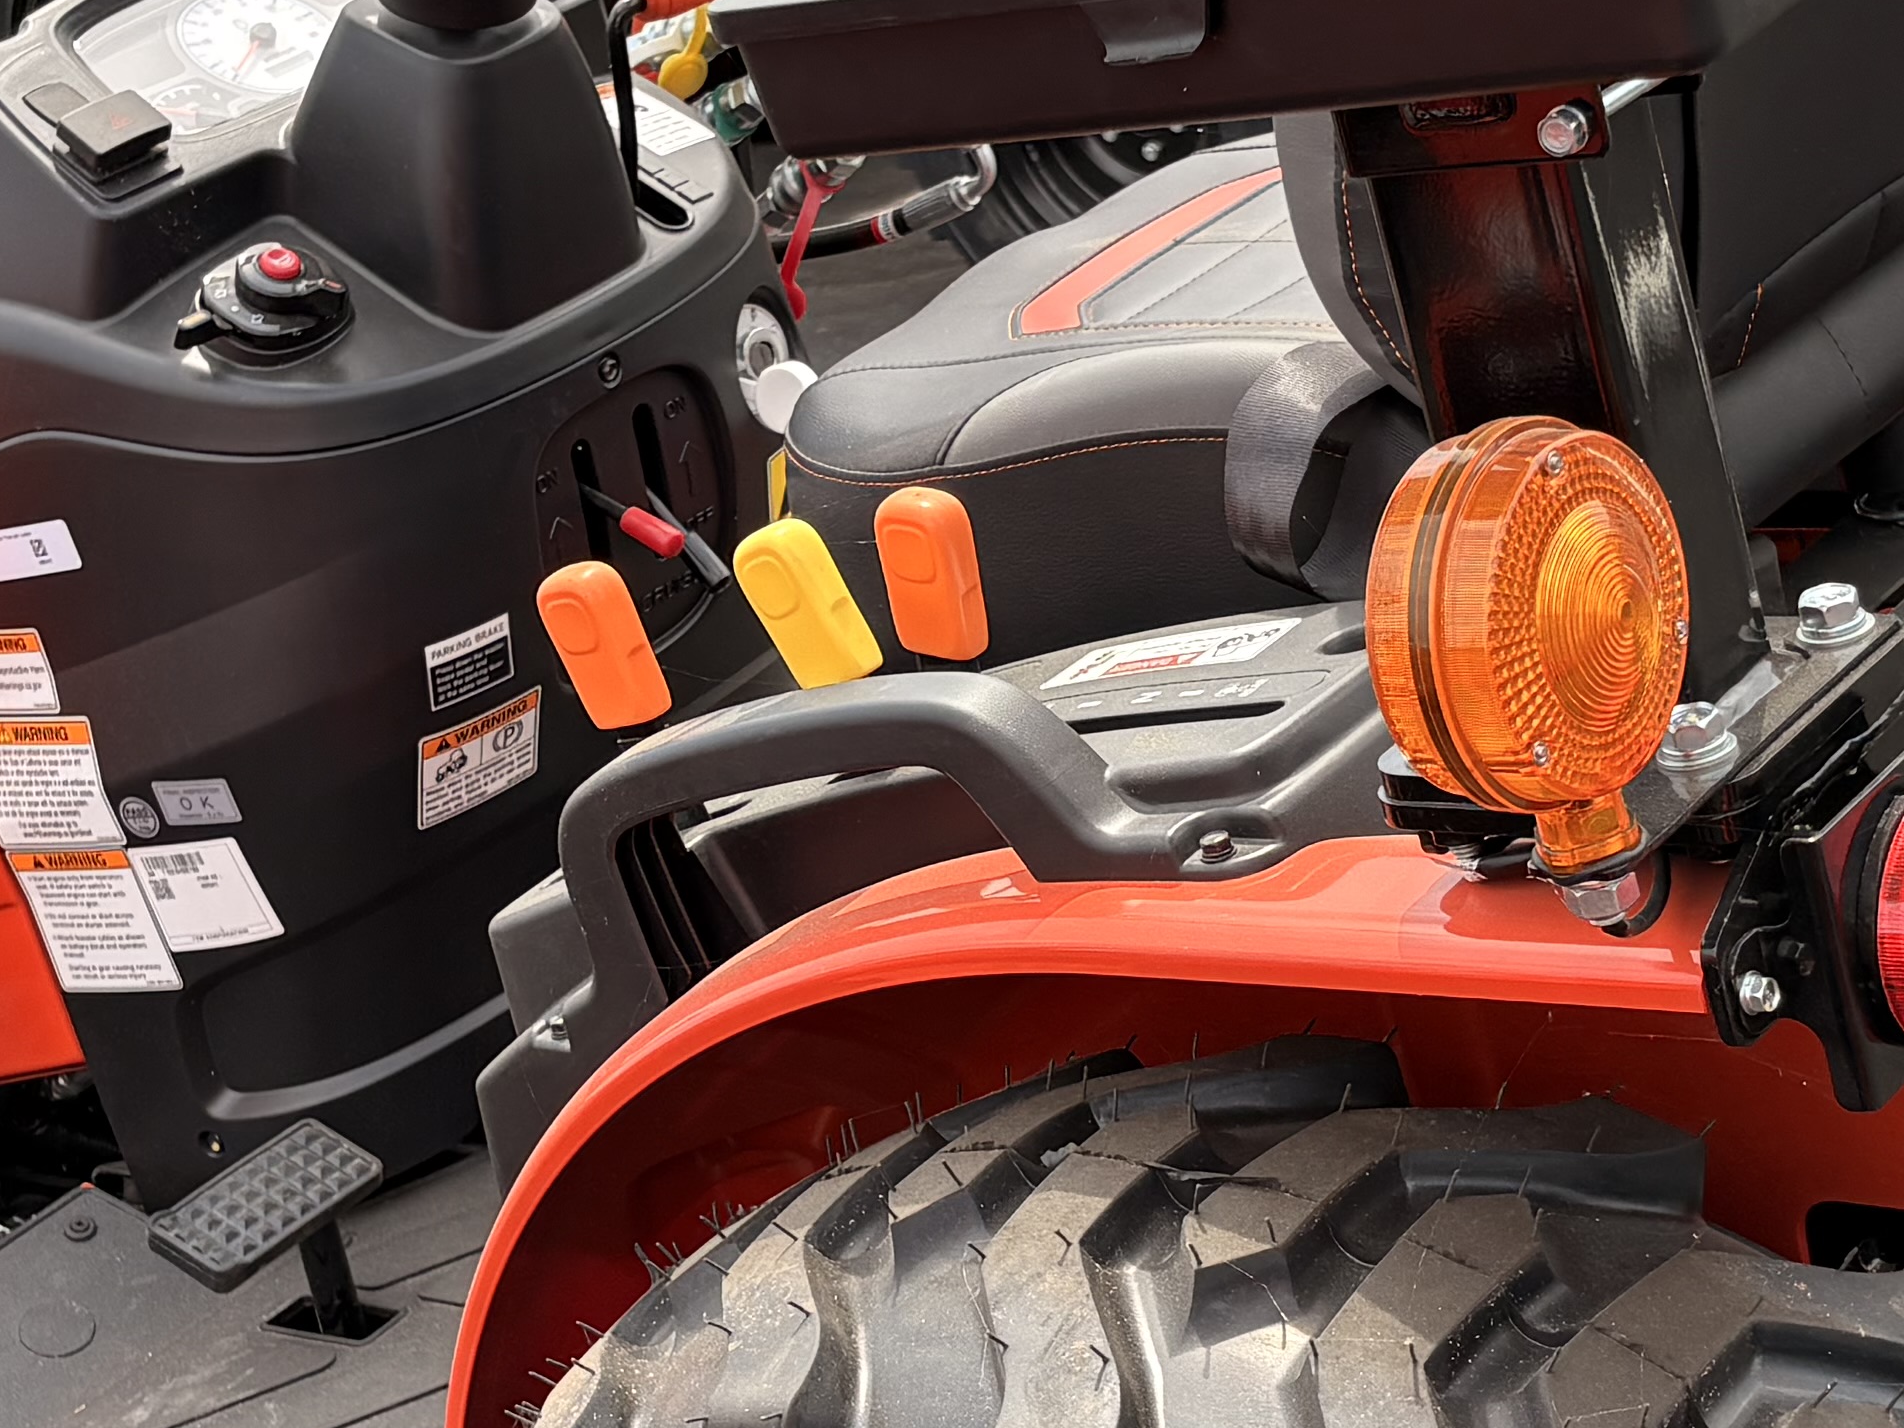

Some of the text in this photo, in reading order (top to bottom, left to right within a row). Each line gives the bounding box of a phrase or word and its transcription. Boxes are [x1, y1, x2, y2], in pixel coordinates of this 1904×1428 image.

[431, 622, 505, 661] PARKING BRAKE
[11, 726, 69, 742] WARNING
[454, 698, 529, 745] WARNING
[42, 853, 109, 869] WARNING
